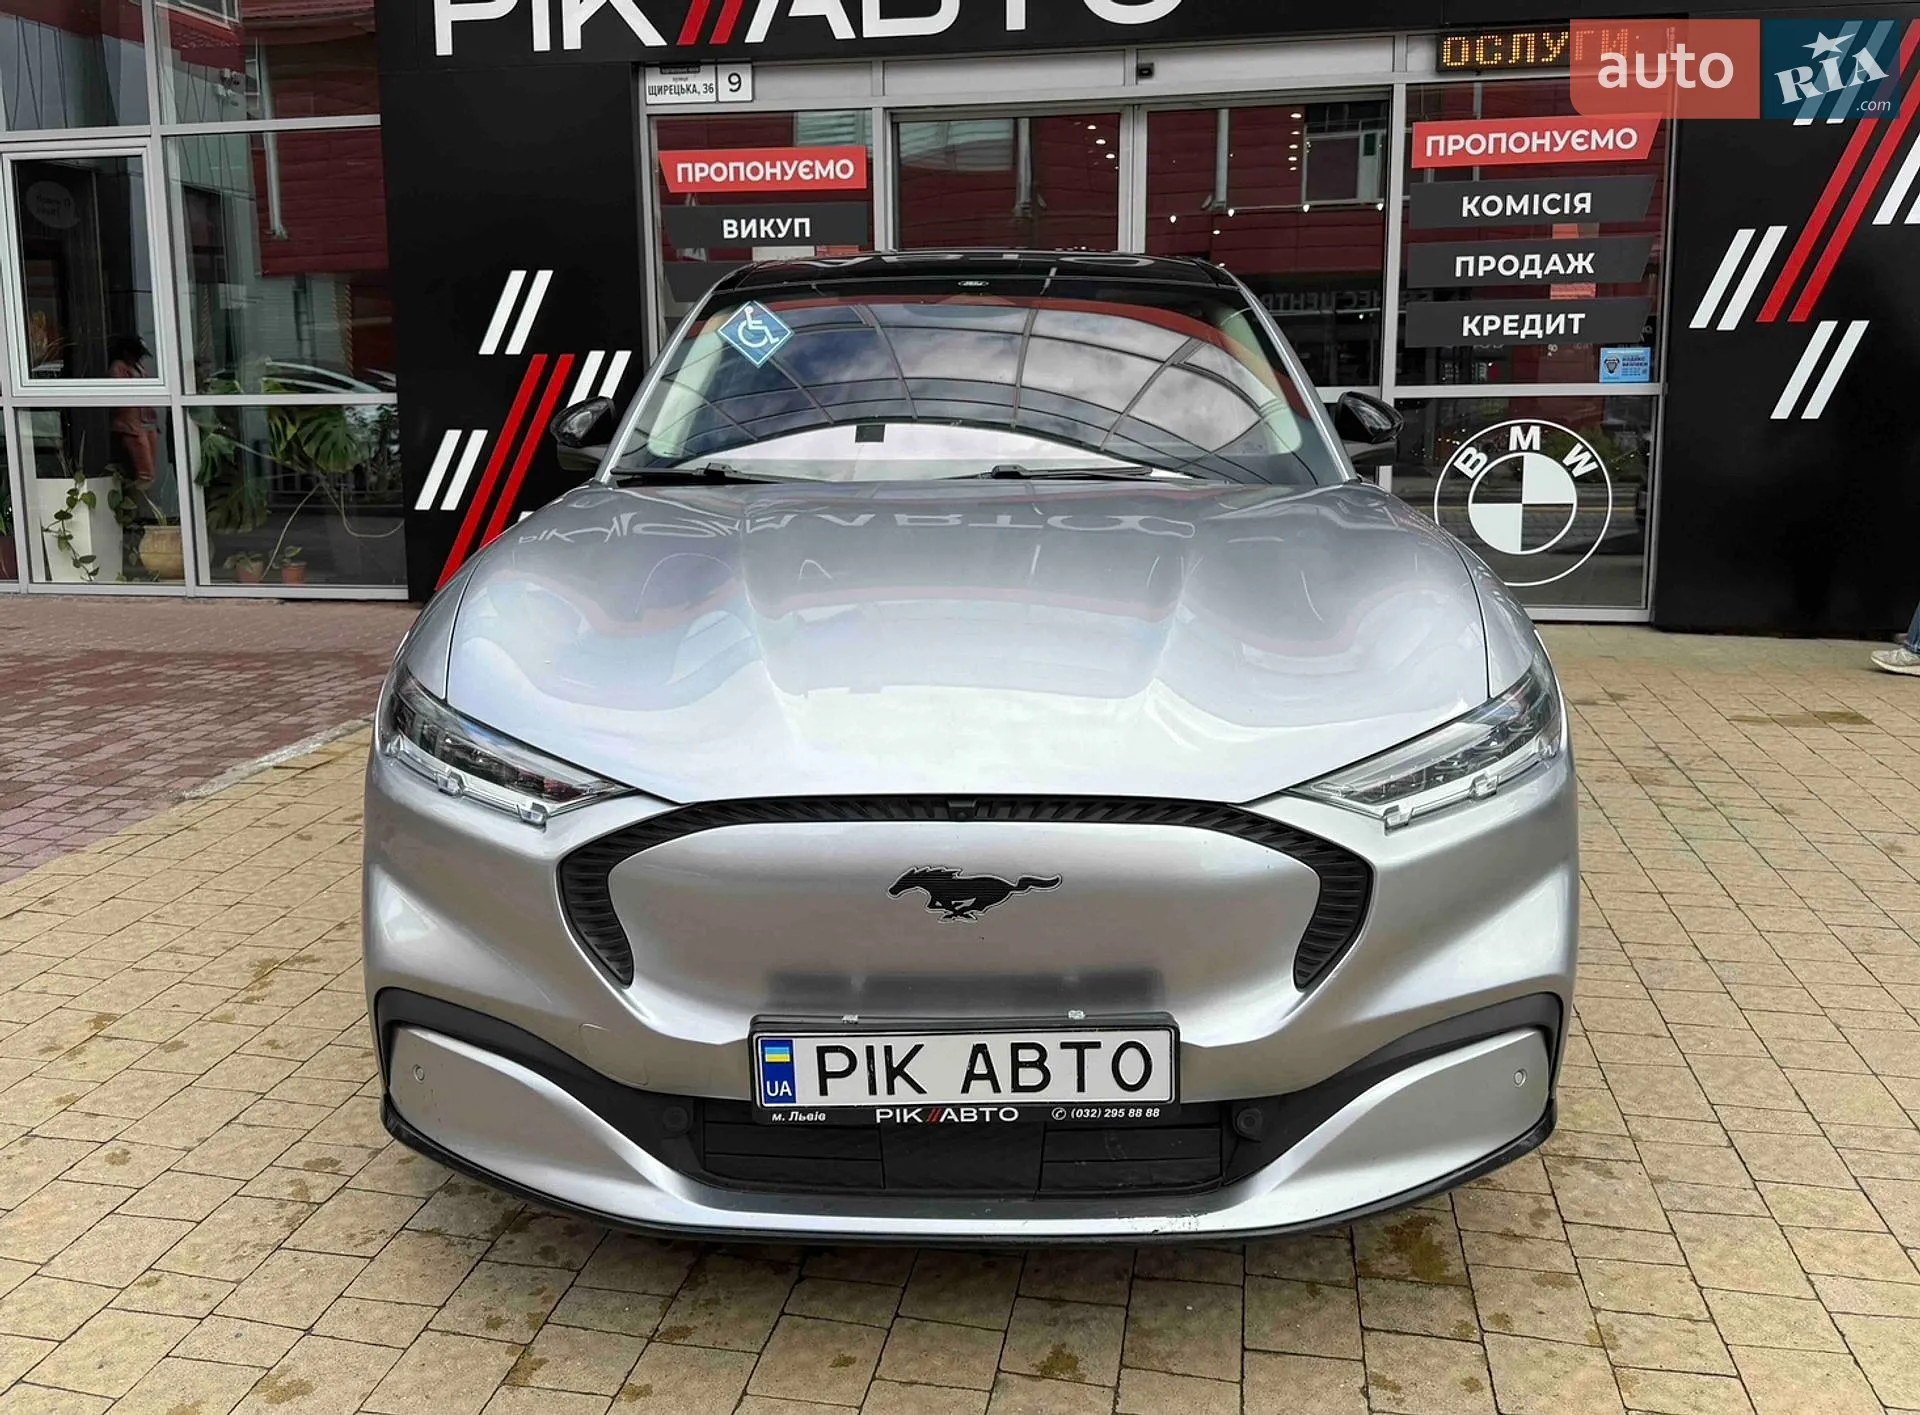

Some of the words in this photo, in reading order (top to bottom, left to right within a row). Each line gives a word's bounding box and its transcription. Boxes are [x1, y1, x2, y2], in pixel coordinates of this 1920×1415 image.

[647, 84, 701, 97] ЩИРЕЦЬКА,
[702, 83, 714, 94] 36
[727, 72, 742, 93] 9
[1425, 127, 1639, 158] ПРОПОНУЄМО
[676, 159, 855, 183] ПРОПОНУЄМО
[1461, 192, 1593, 218] КОМІСІЯ
[722, 217, 811, 240] ВИКУП
[1454, 252, 1596, 279] ПРОДАЖ
[1462, 312, 1586, 339] КРЕДИТ
[1453, 425, 1599, 479] BMW
[816, 1043, 928, 1097] РІК
[960, 1040, 1152, 1094] АВТО
[766, 1081, 793, 1097] UA
[1070, 1107, 1101, 1119] (032)
[1103, 1107, 1126, 1118] 295
[1128, 1107, 1143, 1118] 88
[1145, 1107, 1160, 1118] 88
